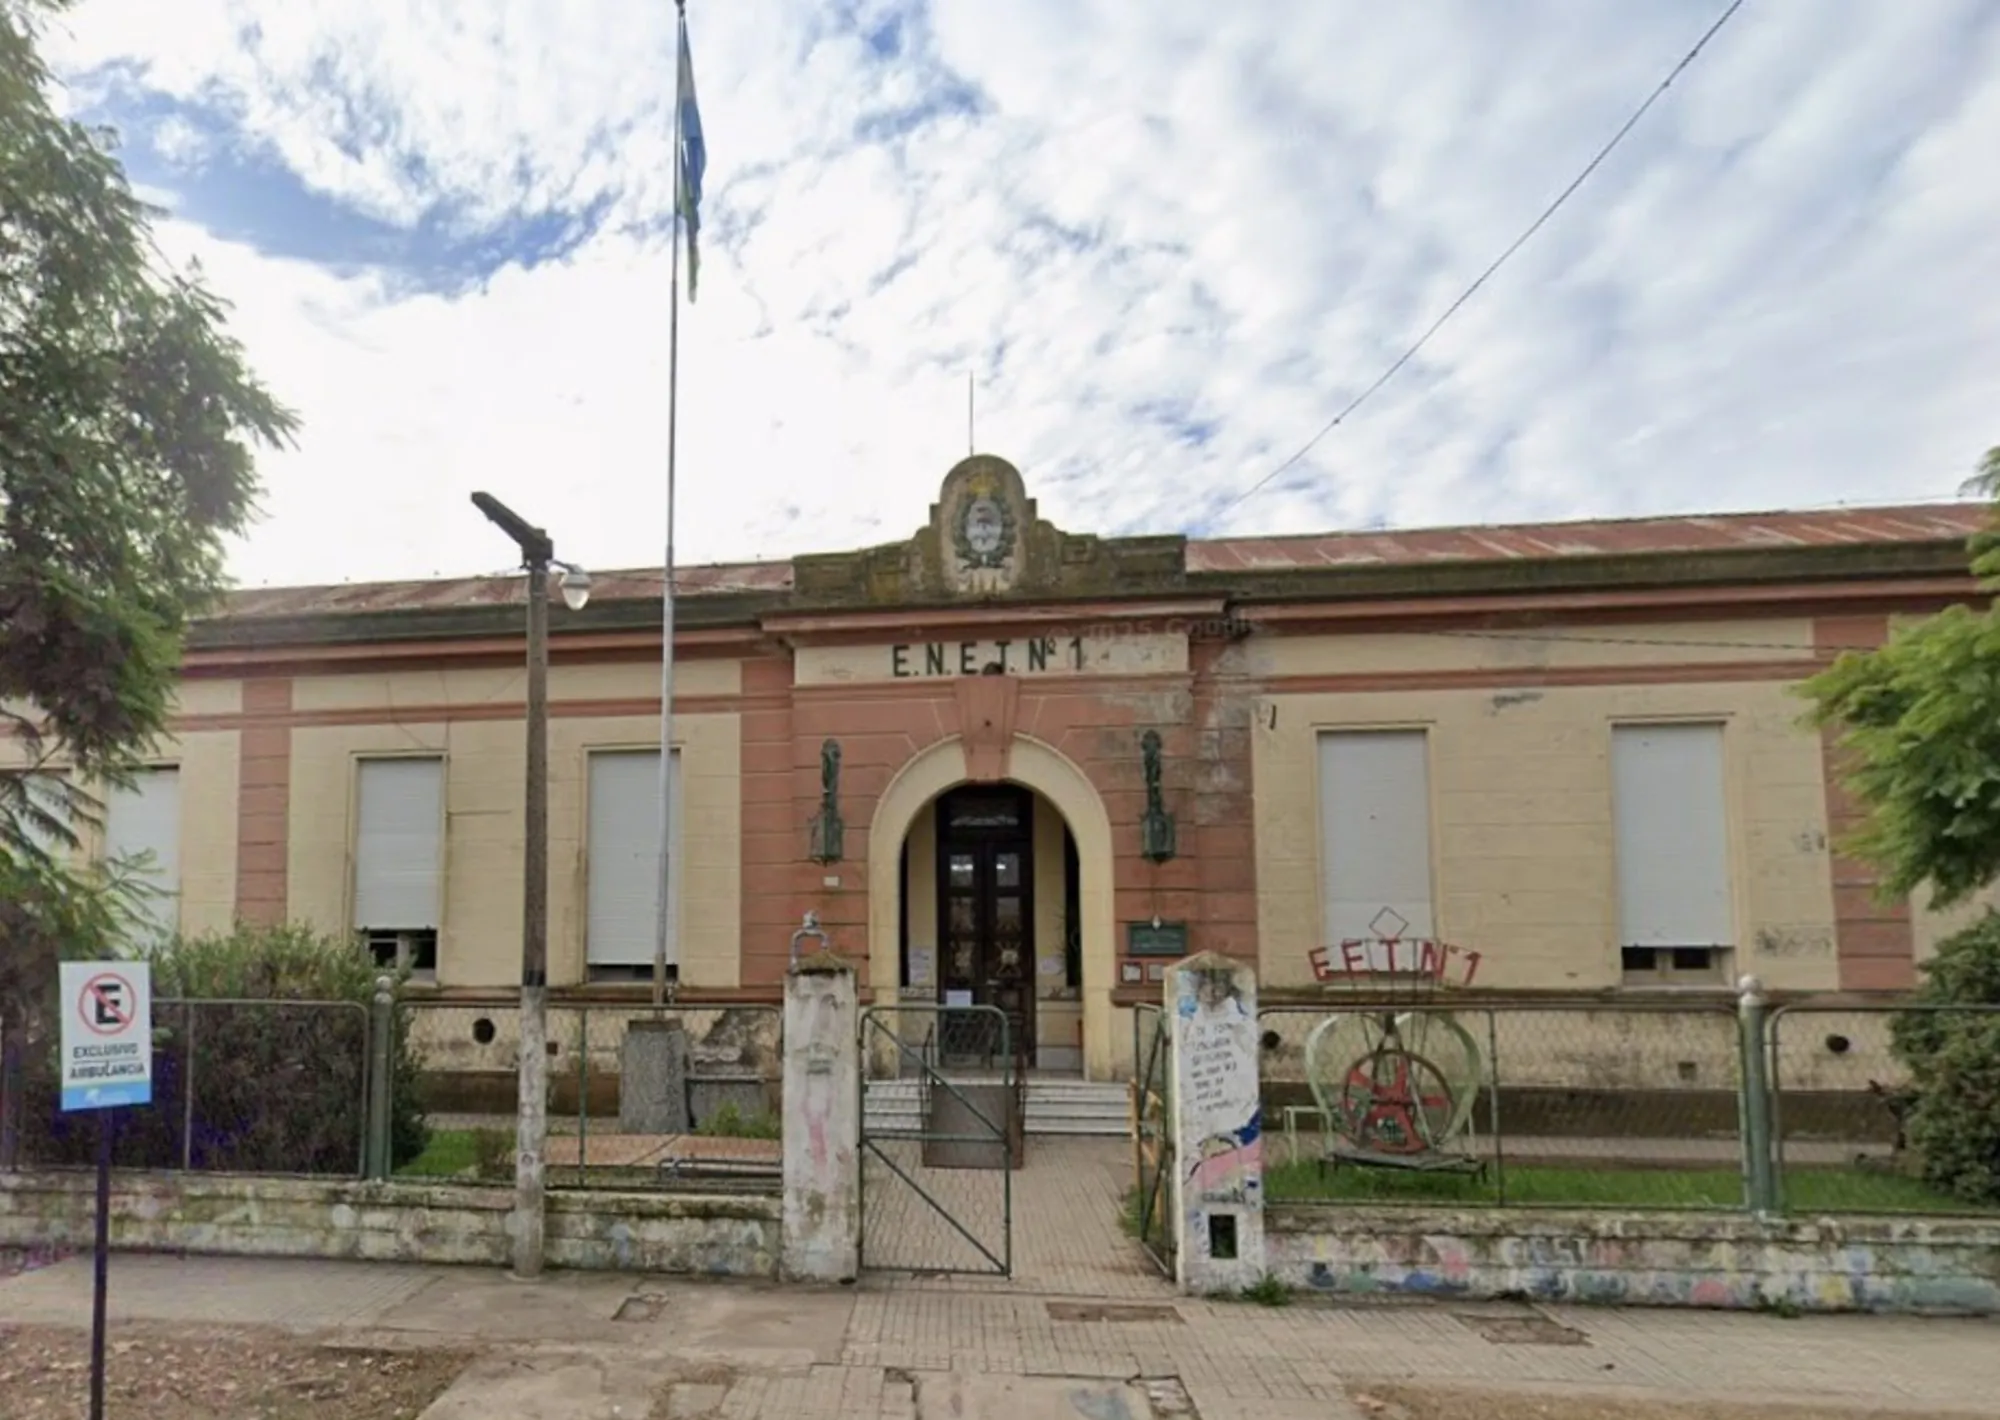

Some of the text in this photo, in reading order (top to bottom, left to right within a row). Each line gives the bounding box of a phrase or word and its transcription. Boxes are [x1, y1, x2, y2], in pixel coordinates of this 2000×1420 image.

[1070, 636, 1082, 671] 1
[1464, 950, 1482, 987] 1
[69, 1062, 145, 1079] AMBULANCIA
